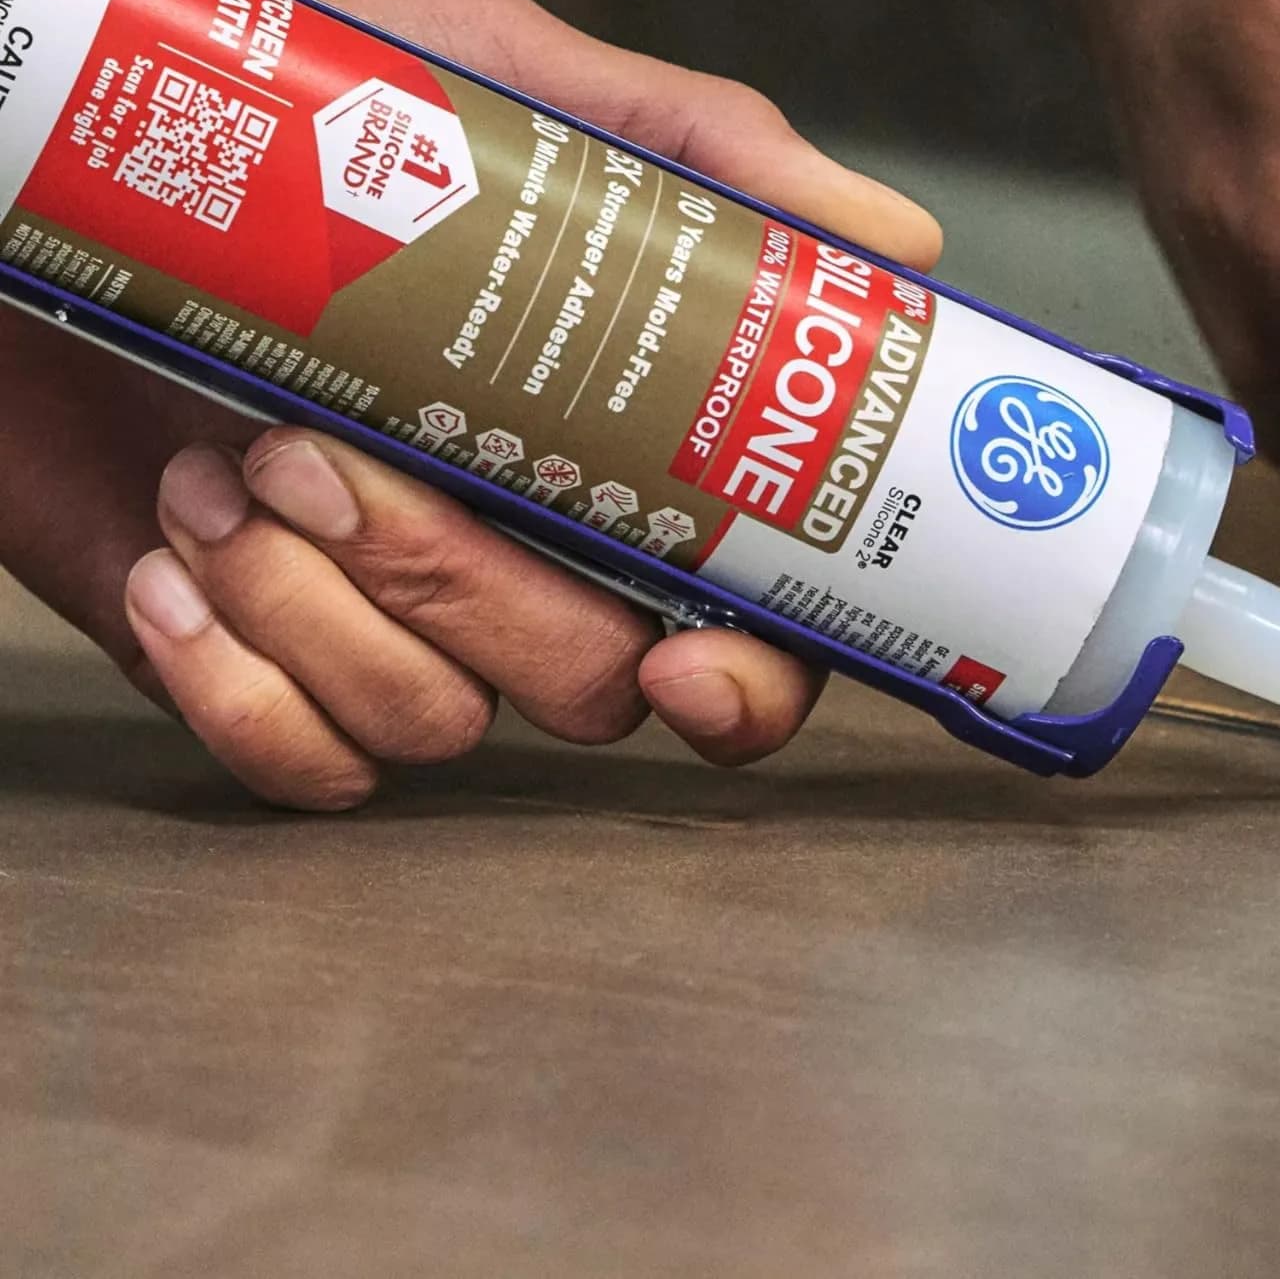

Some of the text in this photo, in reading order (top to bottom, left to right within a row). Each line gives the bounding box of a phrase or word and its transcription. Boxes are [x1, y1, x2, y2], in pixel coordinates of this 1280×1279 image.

[69, 57, 122, 146] done right
[86, 54, 152, 168] Scan for a job
[365, 110, 412, 200] SILICONE
[400, 133, 451, 189] #1
[443, 113, 568, 369] 30 Minute Water-Ready
[521, 150, 640, 394] 5X Stronger Adhesion
[607, 191, 715, 413] 10 Years Mold-Free
[690, 230, 788, 458] 100% WATERPROOF
[722, 246, 871, 515] SILICONE
[802, 278, 925, 540] 100% ADVANCED
[862, 485, 904, 548] Silicone
[871, 494, 920, 568] CLEAR
